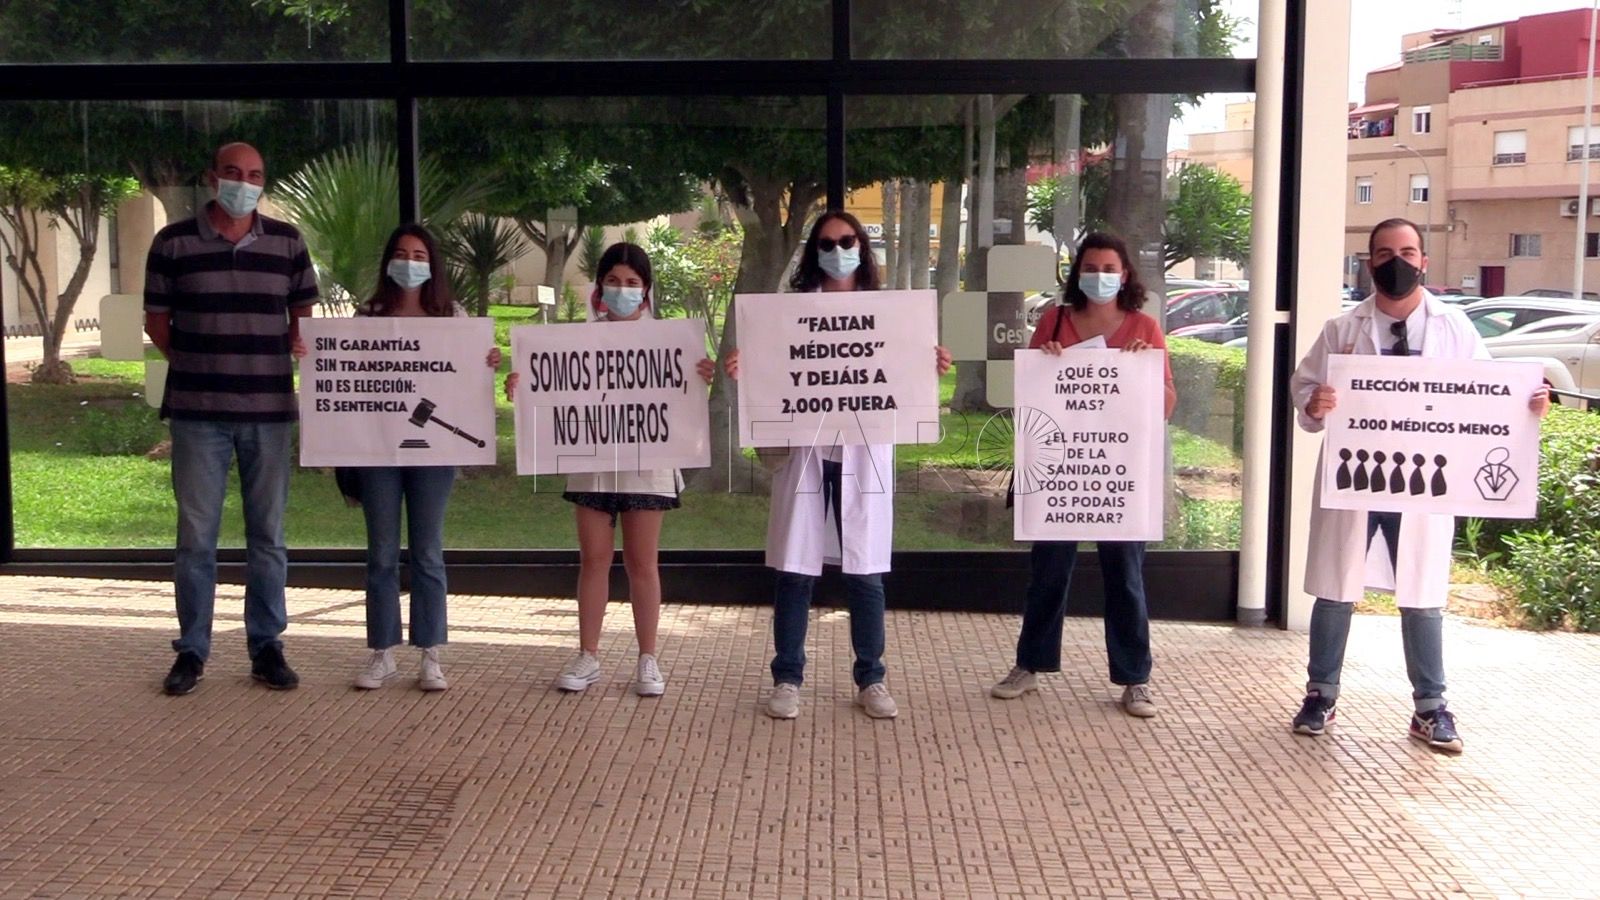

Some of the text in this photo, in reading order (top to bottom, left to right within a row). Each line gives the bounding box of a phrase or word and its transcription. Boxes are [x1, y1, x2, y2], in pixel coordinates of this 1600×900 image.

[315, 337, 420, 352] SIN GARANTÍAS
[315, 358, 337, 372] SIN
[530, 347, 688, 395] SOMOS PERSONAS,
[1056, 364, 1119, 381] ¿QUÉ OS
[789, 366, 888, 387] Y DEJÁIS A
[315, 377, 416, 393] NO ES ELECCIÓN:
[1055, 383, 1120, 395] IMPORTA
[1350, 378, 1511, 396] ELECCIÓN TELEMÁTICA
[315, 398, 408, 413] ES SENTENCIA
[781, 395, 898, 414] 2.000 FUERA
[1065, 399, 1105, 411] MAS?
[553, 392, 670, 447] NO NÚMEROS
[1348, 417, 1510, 436] 2.000 MÉDICOS MENOS
[1045, 432, 1129, 446] ¿EL FUTURO
[1067, 448, 1107, 460] DE LA
[1047, 464, 1127, 476] SANIDAD O
[1039, 480, 1135, 494] TODO LO QUE
[1047, 496, 1126, 508] OS PODAIS
[1045, 512, 1124, 524] AHORRAR?
